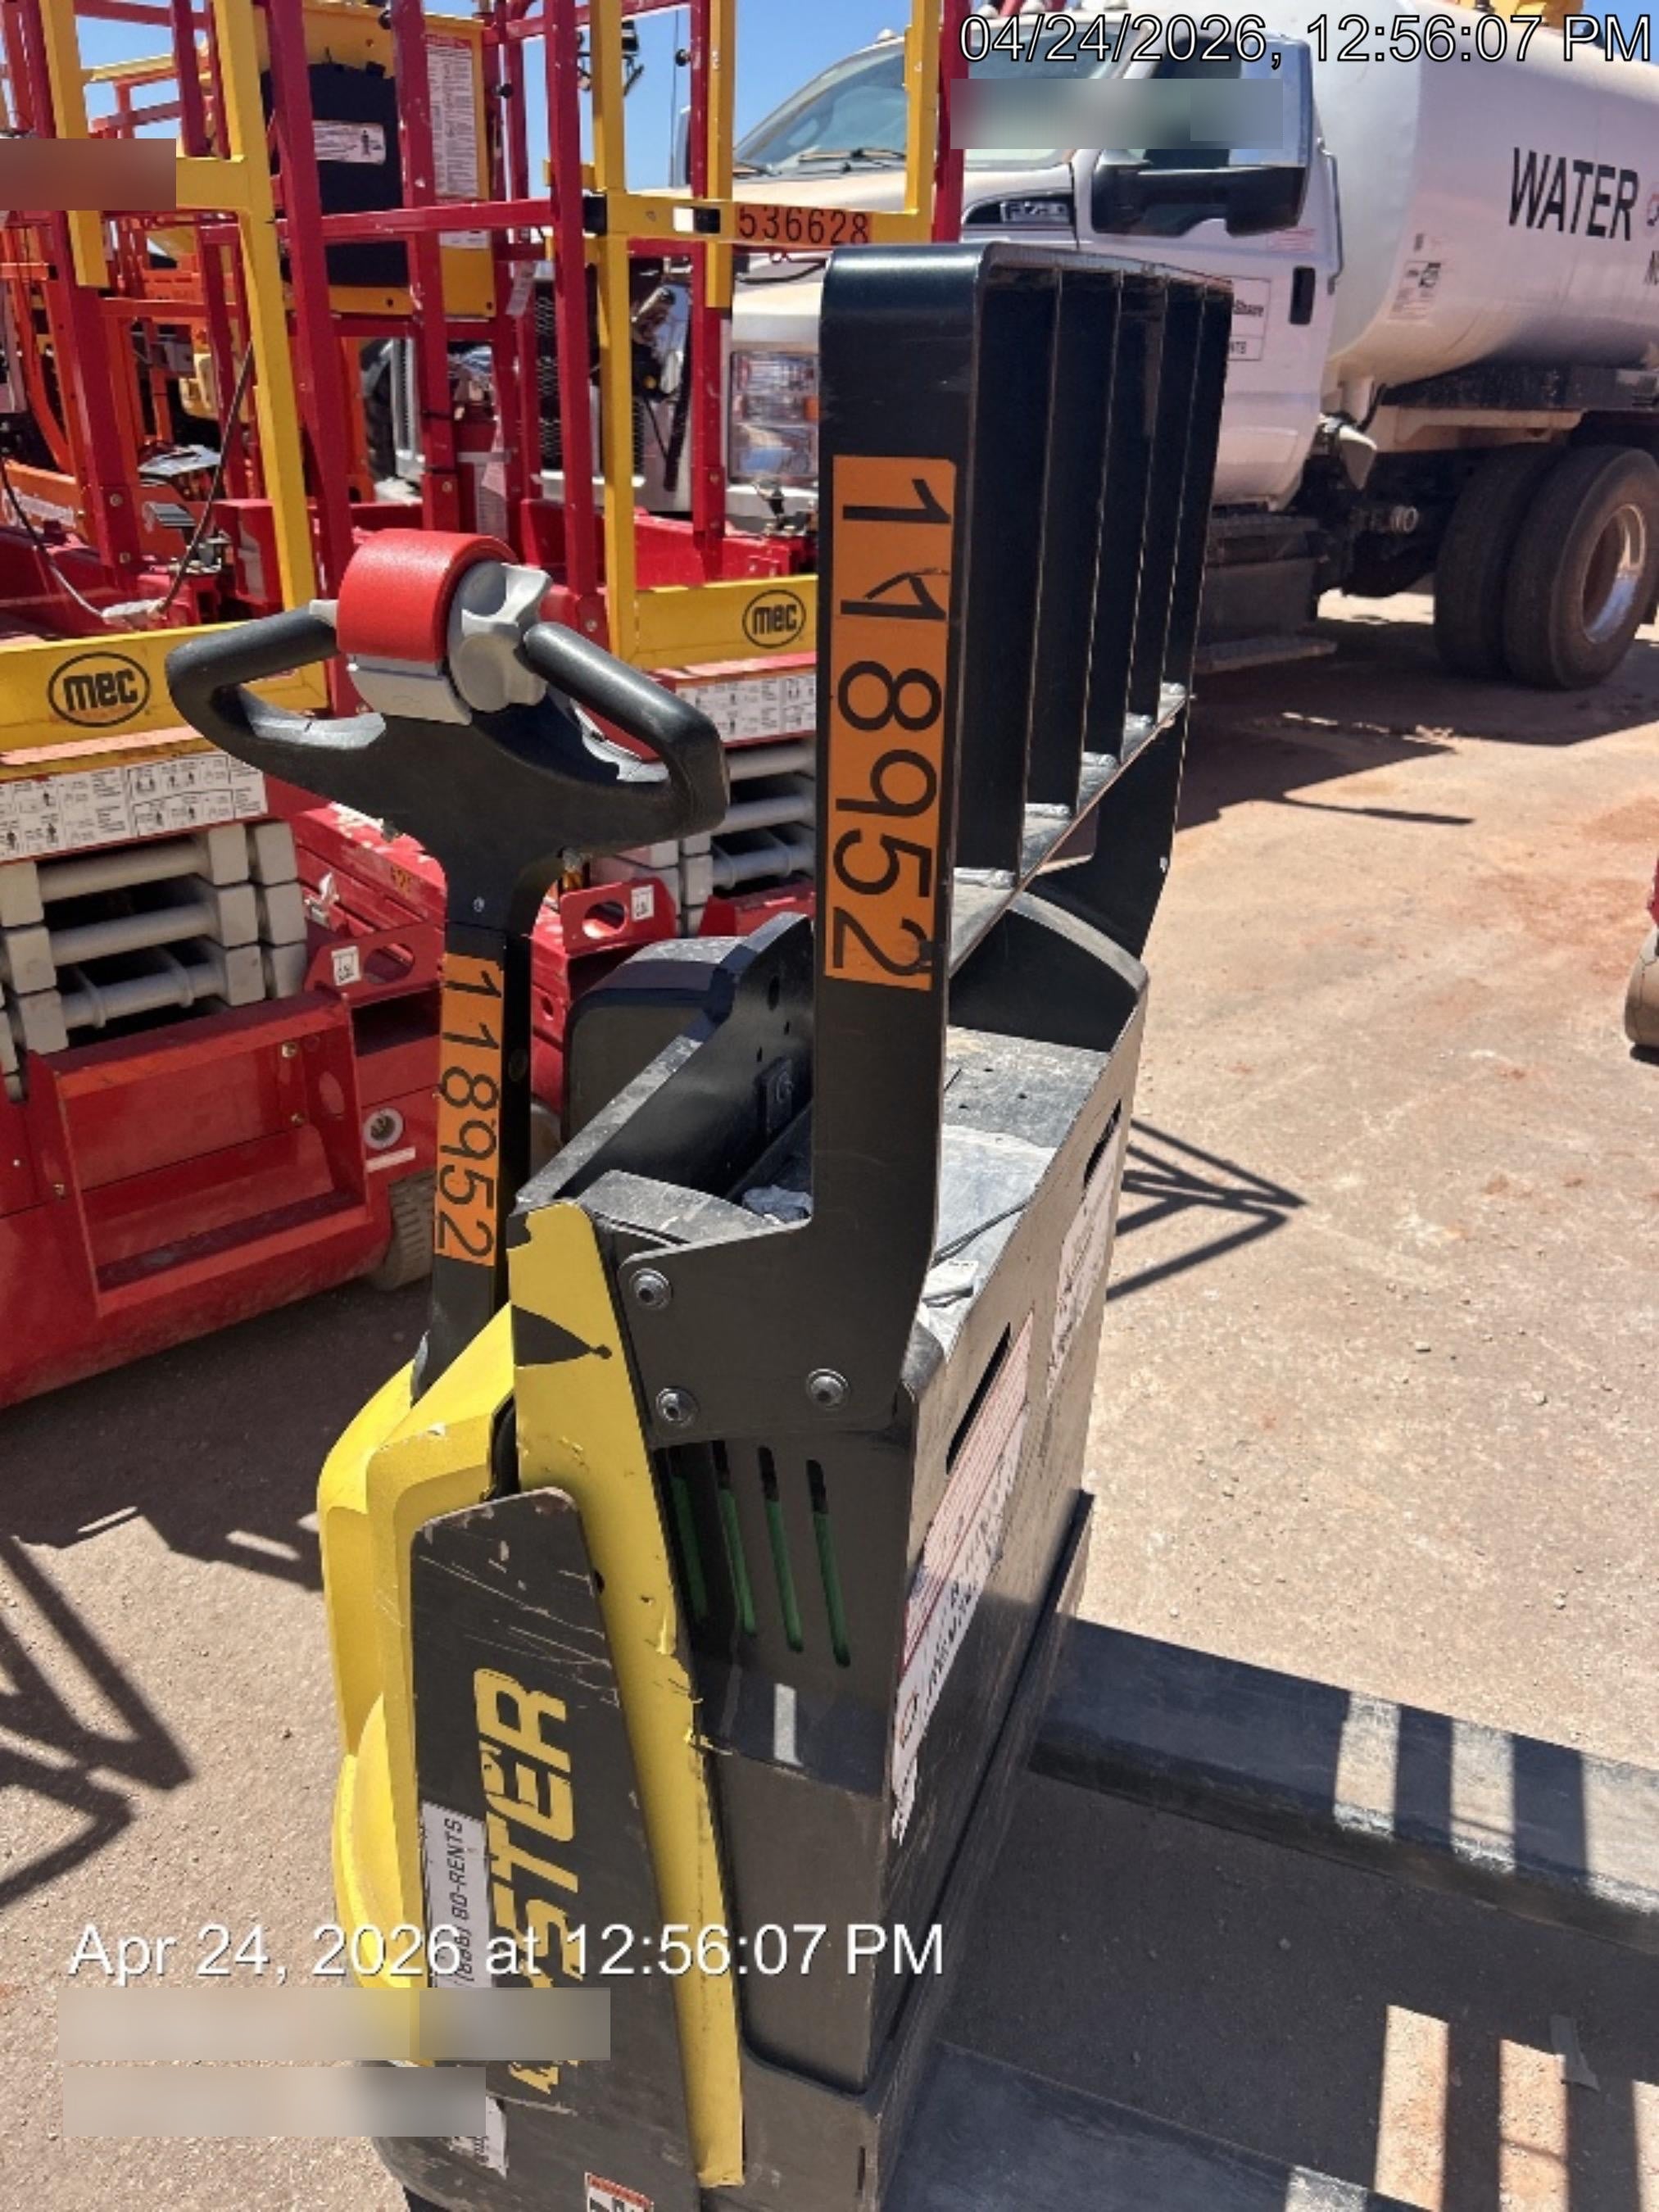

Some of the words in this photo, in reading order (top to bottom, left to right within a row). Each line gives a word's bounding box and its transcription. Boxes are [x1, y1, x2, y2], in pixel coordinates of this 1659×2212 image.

[739, 206, 869, 244] 536628
[1509, 147, 1639, 241] WATER
[832, 478, 952, 977] 118952
[437, 971, 501, 1257] 118952
